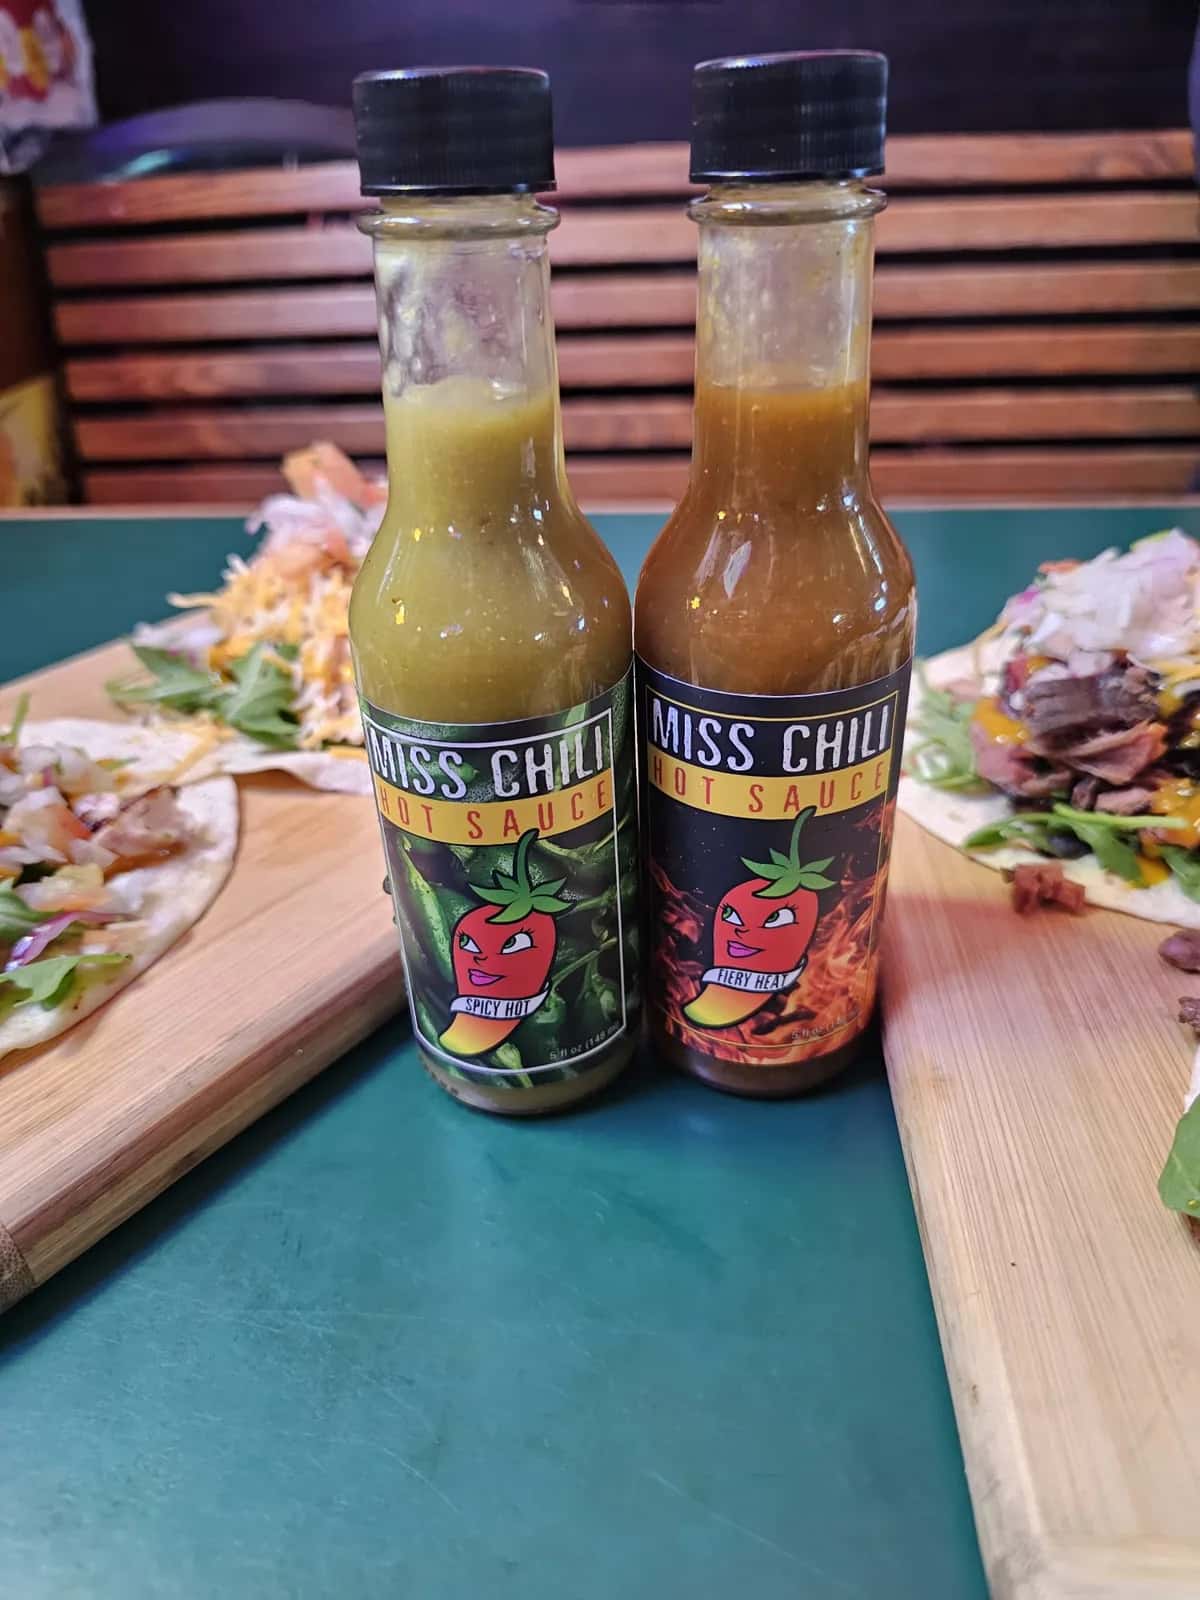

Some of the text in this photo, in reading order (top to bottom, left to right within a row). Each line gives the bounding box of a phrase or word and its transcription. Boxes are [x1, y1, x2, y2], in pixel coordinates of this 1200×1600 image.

[370, 725, 603, 799] MISS CHILI
[652, 697, 889, 772] MISS CHILI
[379, 779, 606, 840] HOT SAUCE
[653, 756, 884, 813] HOT SAUCE
[465, 998, 531, 1017] SPICY HOT
[717, 968, 789, 990] FIERY HEAT
